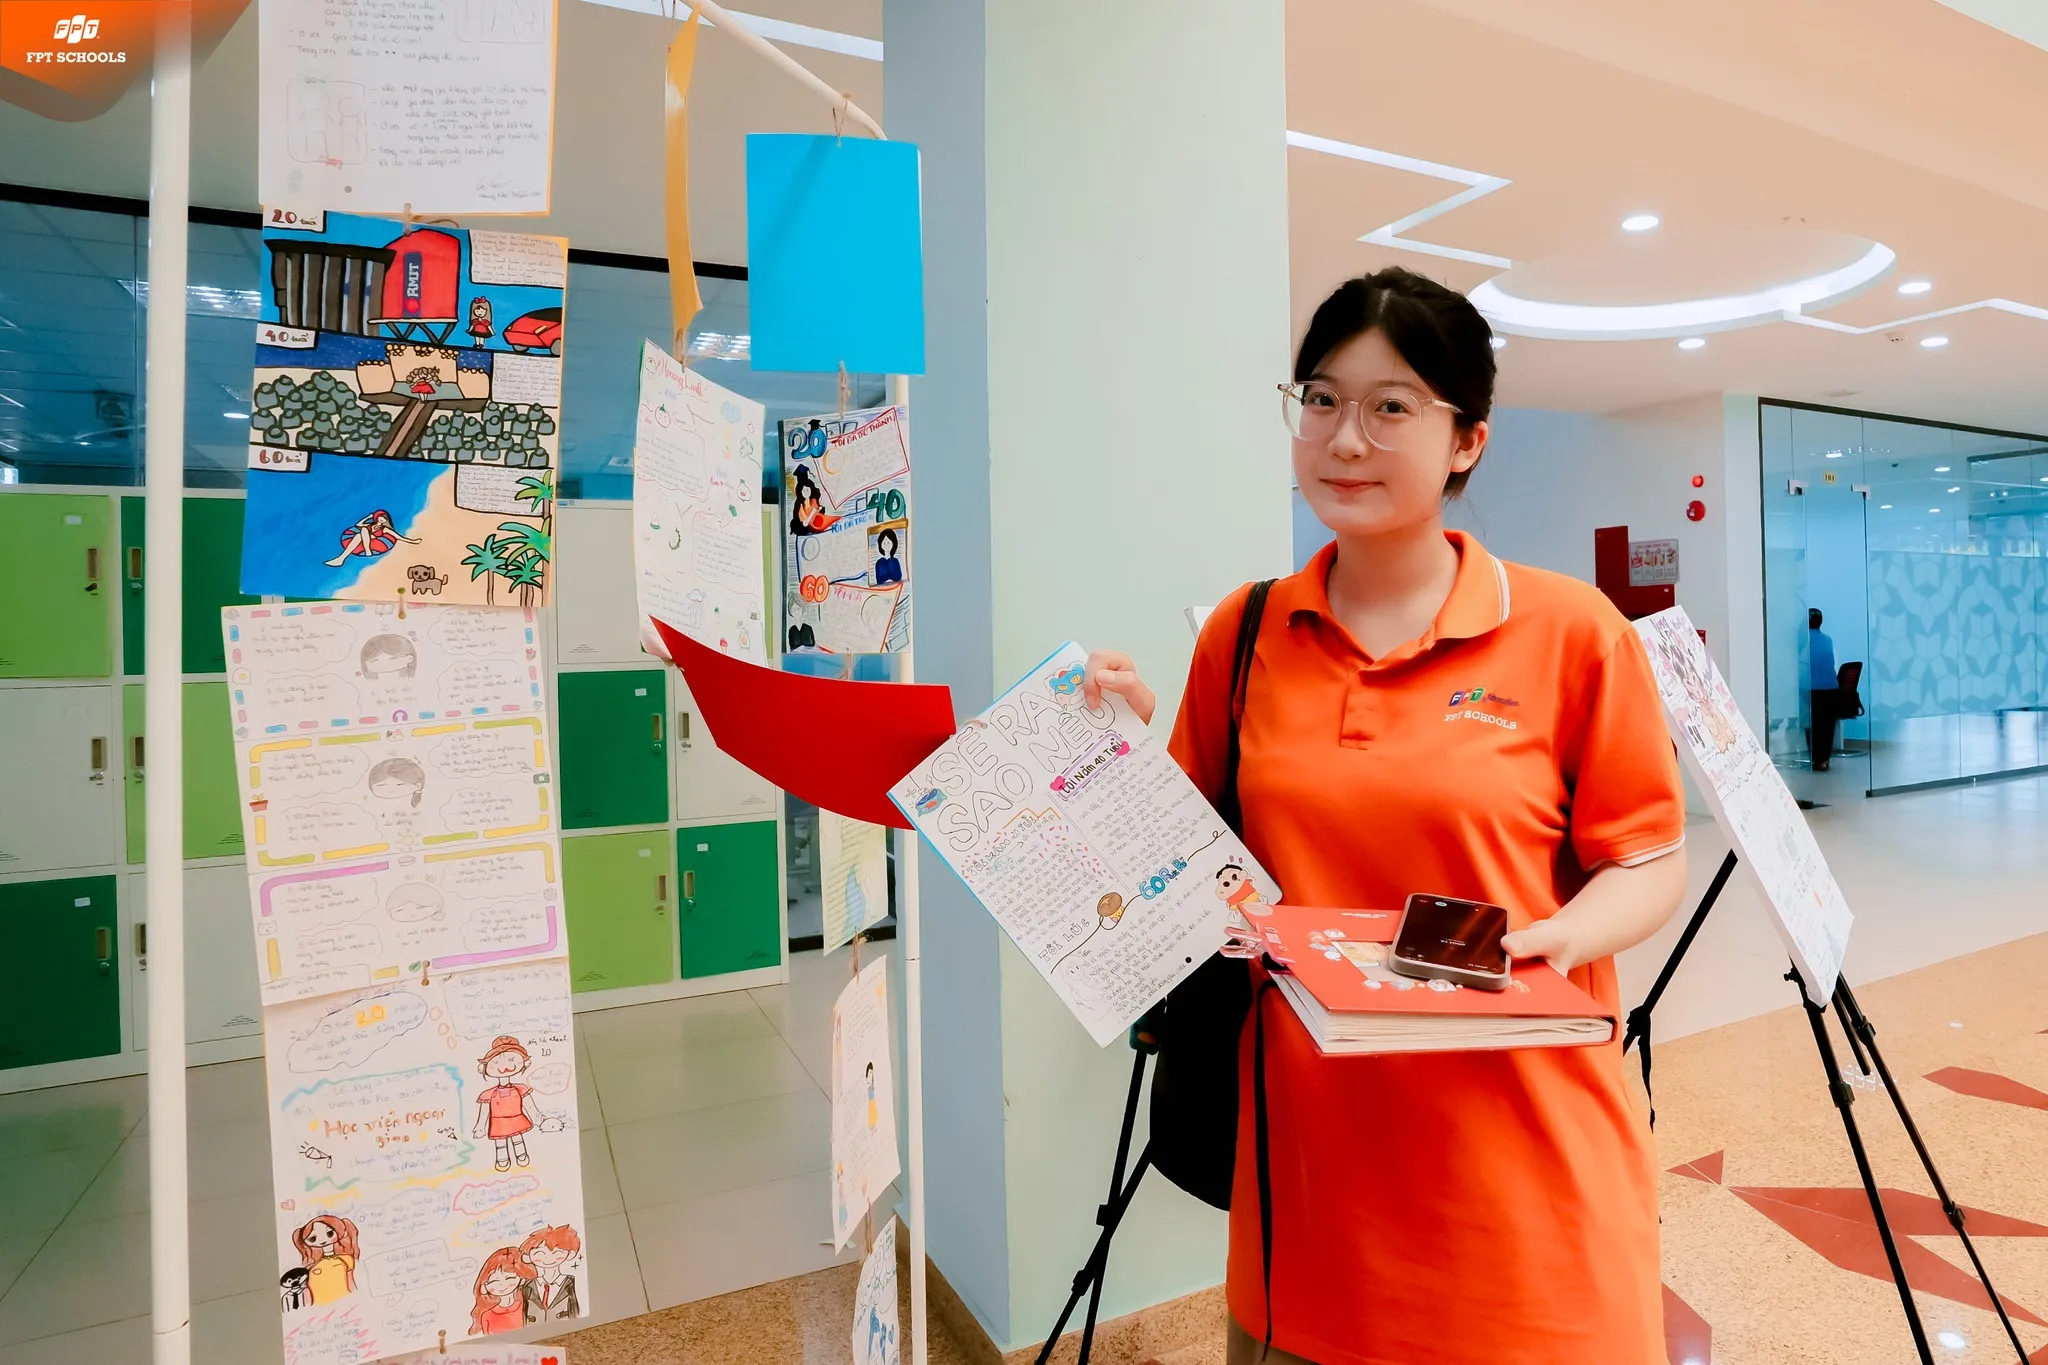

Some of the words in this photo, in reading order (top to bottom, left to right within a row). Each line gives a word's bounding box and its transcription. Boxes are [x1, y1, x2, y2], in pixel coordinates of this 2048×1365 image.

[272, 209, 297, 224] 20
[406, 262, 419, 298] RMIT
[265, 329, 289, 343] 40
[788, 427, 827, 459] 20
[259, 449, 283, 464] 60
[866, 489, 907, 523] 40
[800, 575, 830, 603] 60
[1464, 709, 1517, 730] SCHOOLS
[931, 726, 999, 797] SẼ
[990, 691, 1064, 747] RA
[1073, 760, 1095, 780] Năm
[1093, 754, 1104, 765] 40
[936, 763, 1033, 852] SAO
[1138, 873, 1165, 900] 60
[355, 1005, 385, 1024] 20
[540, 1047, 552, 1056] 20
